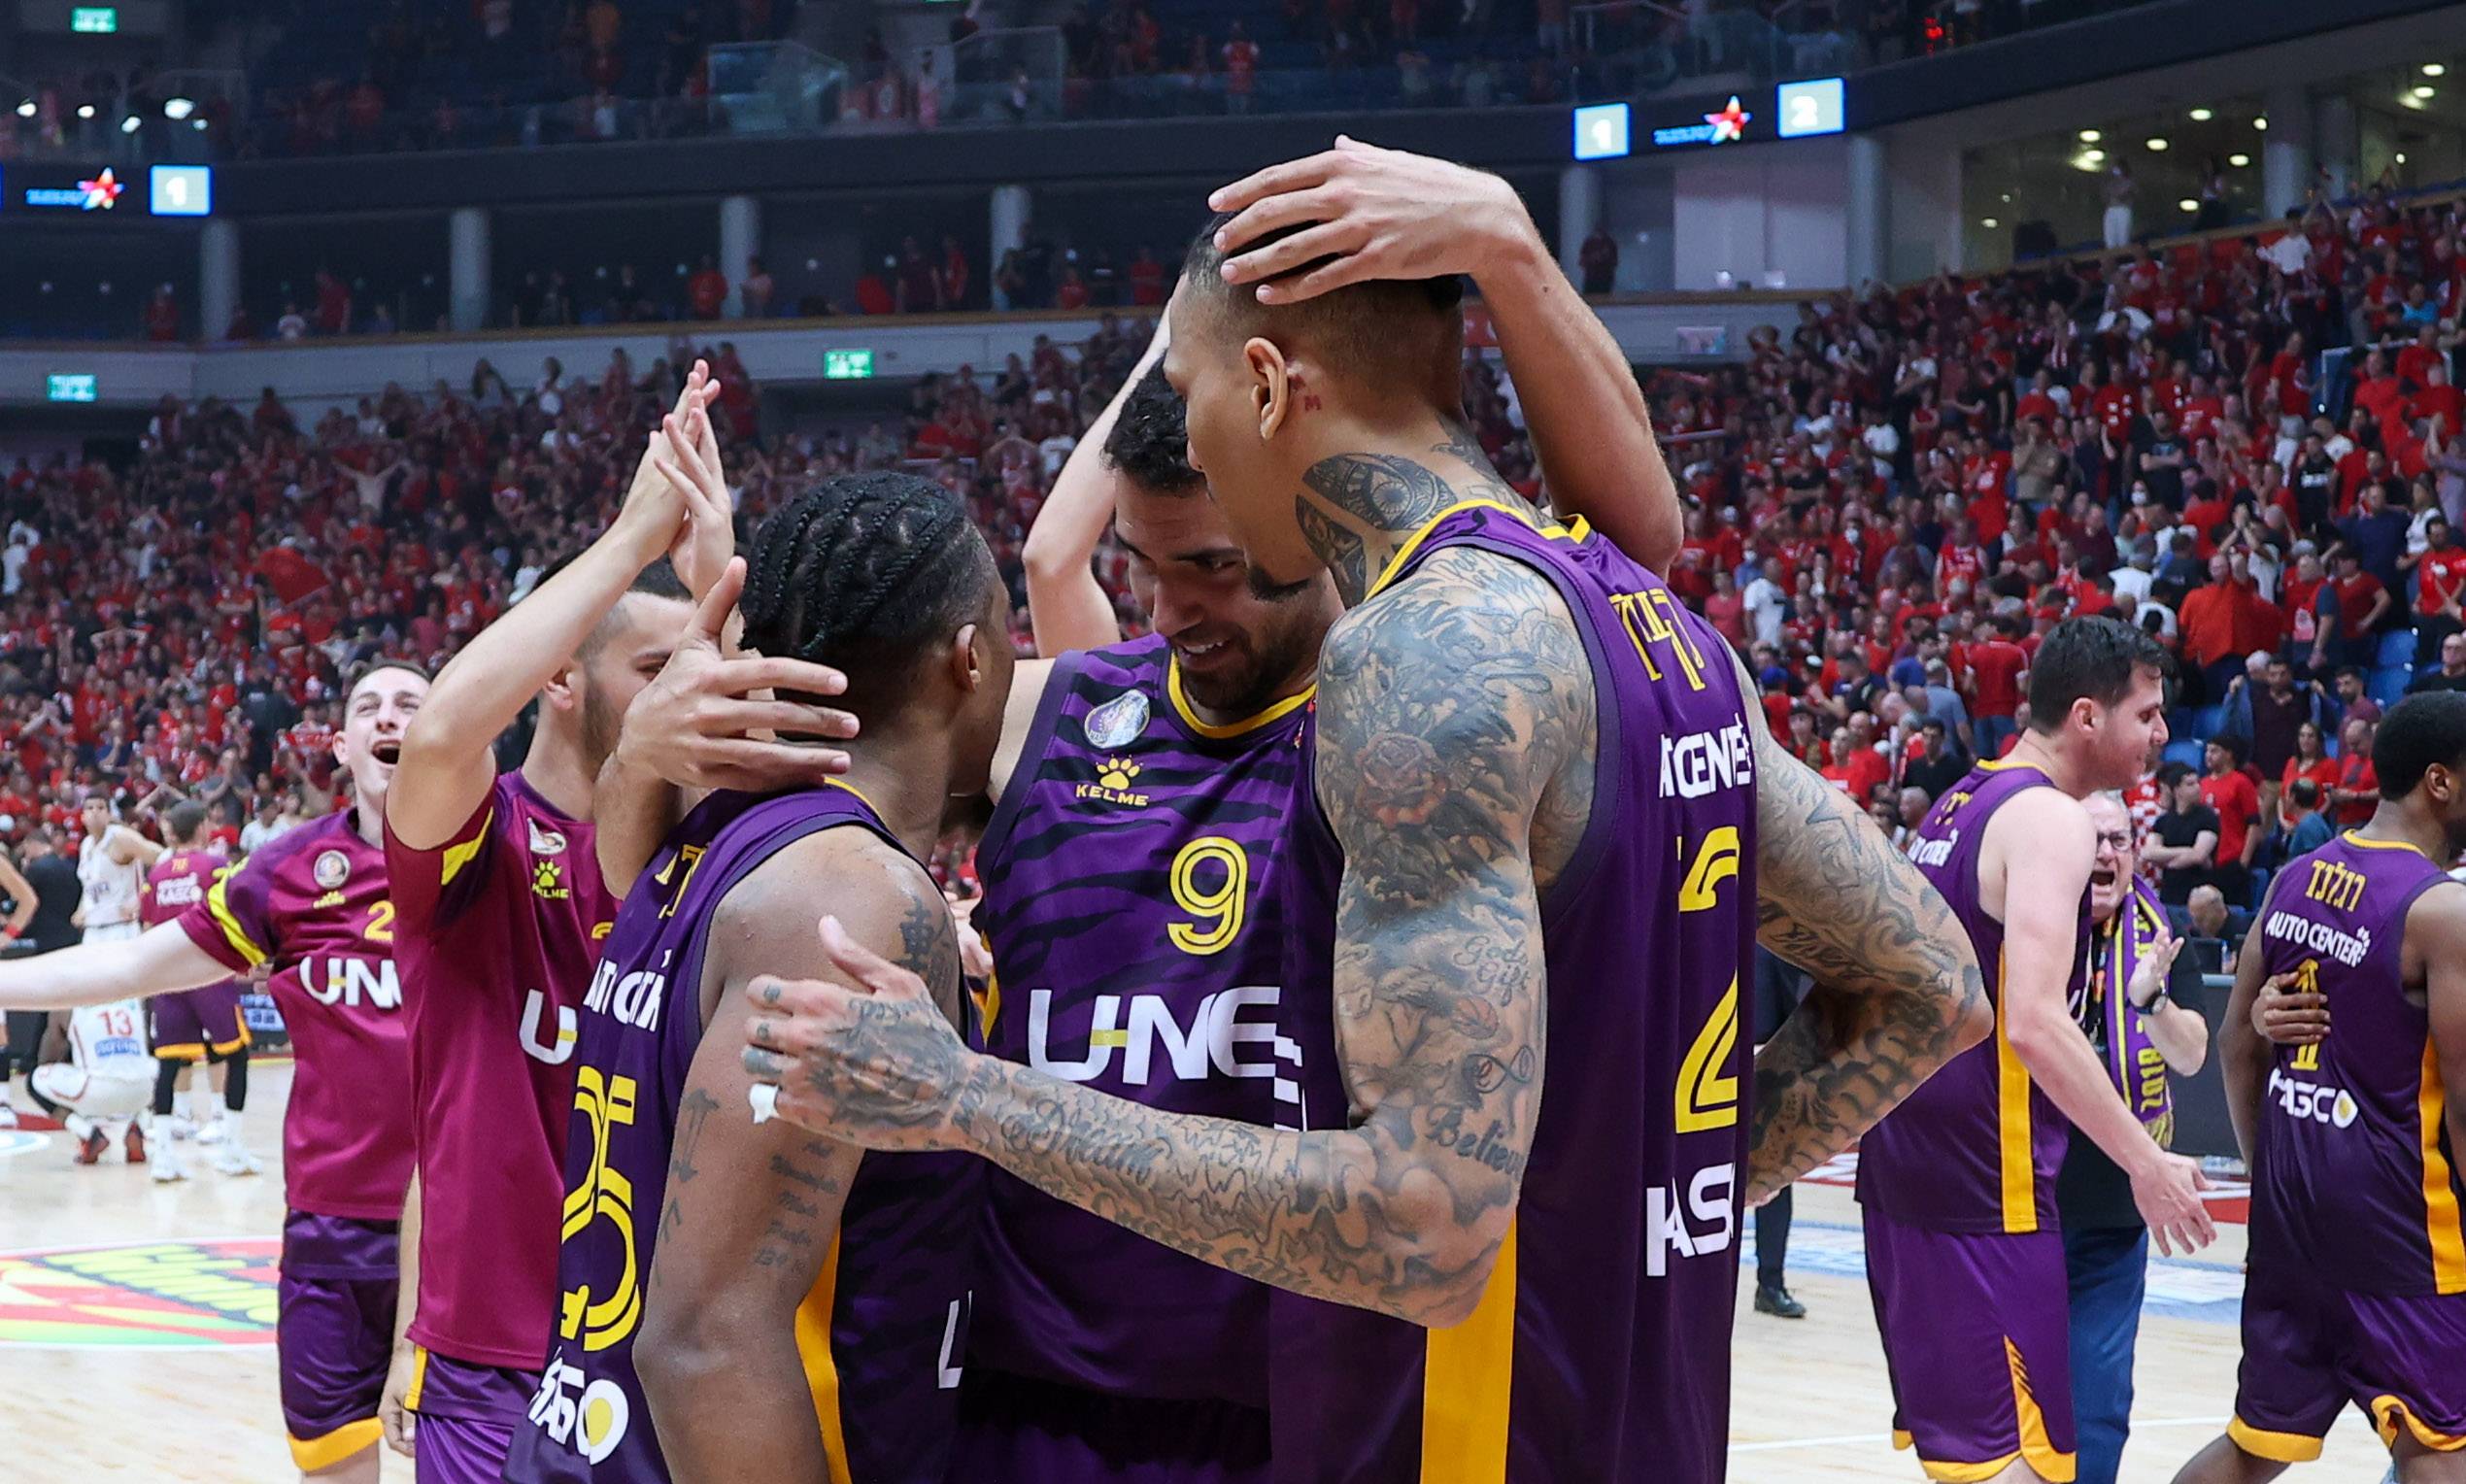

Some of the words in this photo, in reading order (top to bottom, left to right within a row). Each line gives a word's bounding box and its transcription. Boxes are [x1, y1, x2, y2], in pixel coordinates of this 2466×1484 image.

[1075, 783, 1150, 807] KELME
[1166, 835, 1249, 956] 9
[2264, 910, 2309, 945] AUTO
[2307, 922, 2363, 968] CENTER
[300, 956, 403, 1008] UN
[96, 1010, 133, 1037] 13
[1027, 986, 1303, 1102] UNE
